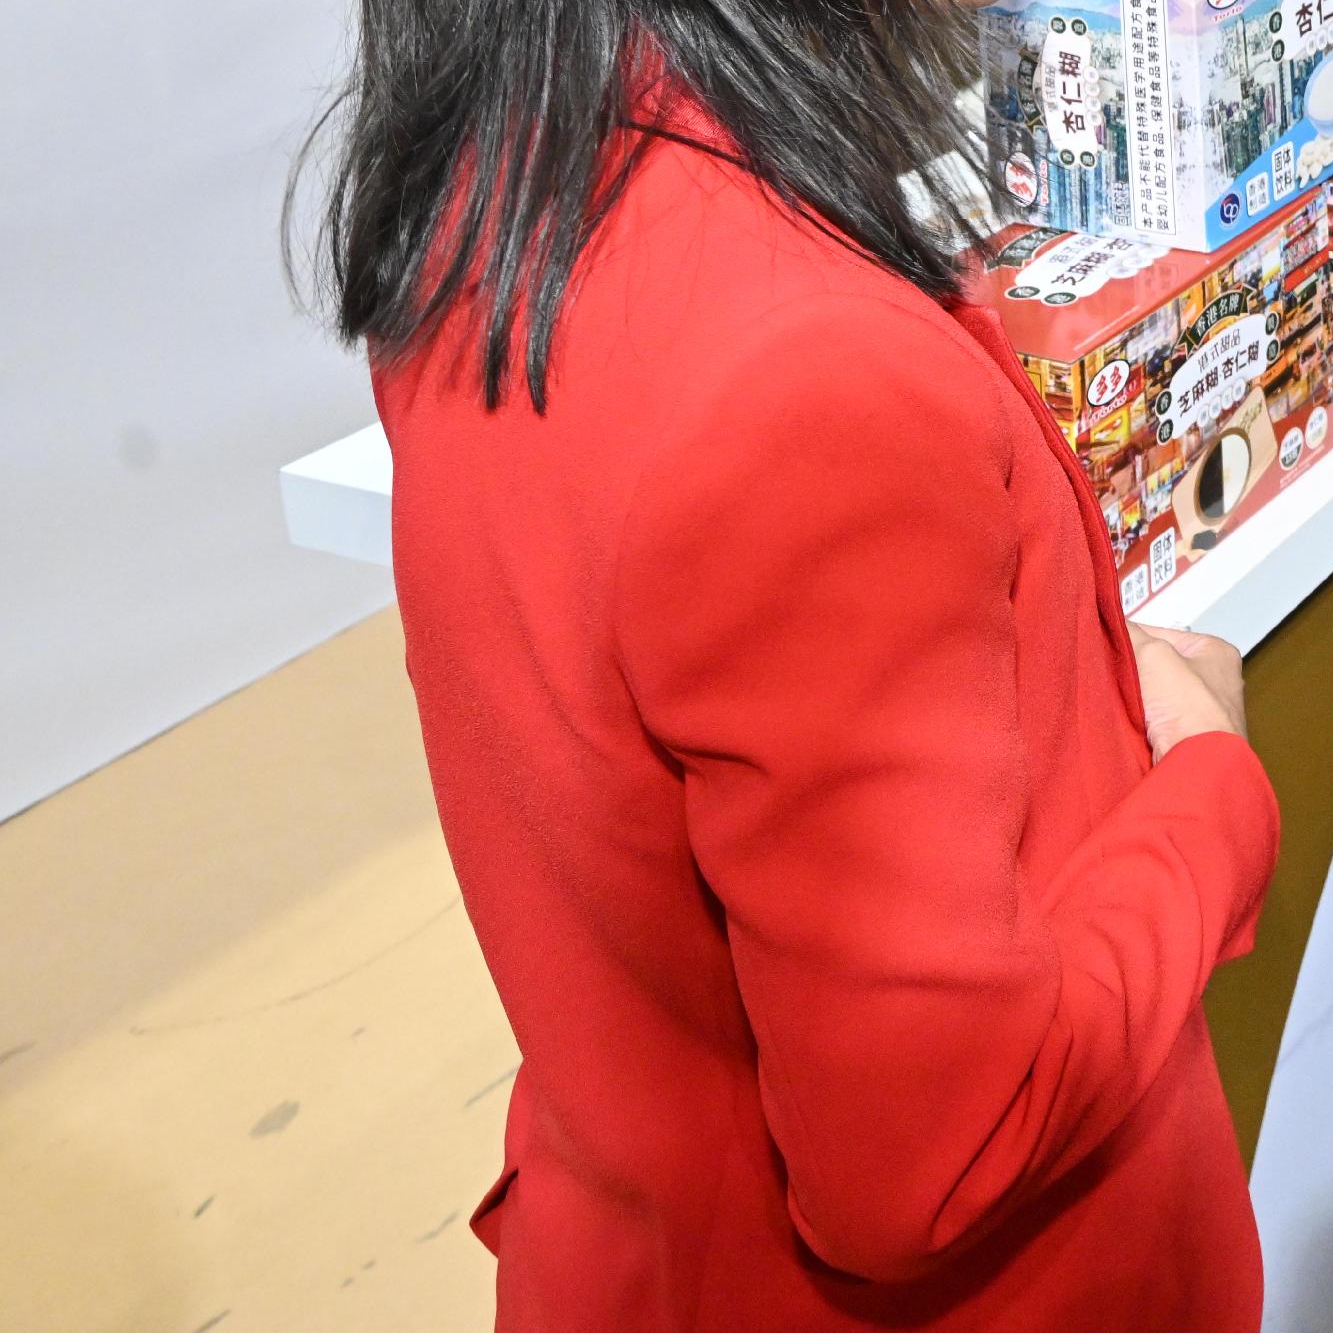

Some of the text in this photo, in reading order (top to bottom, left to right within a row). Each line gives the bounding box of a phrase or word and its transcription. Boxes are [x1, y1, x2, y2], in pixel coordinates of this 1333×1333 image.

[1057, 50, 1087, 135] 杏仁糊
[1095, 366, 1123, 404] 多多
